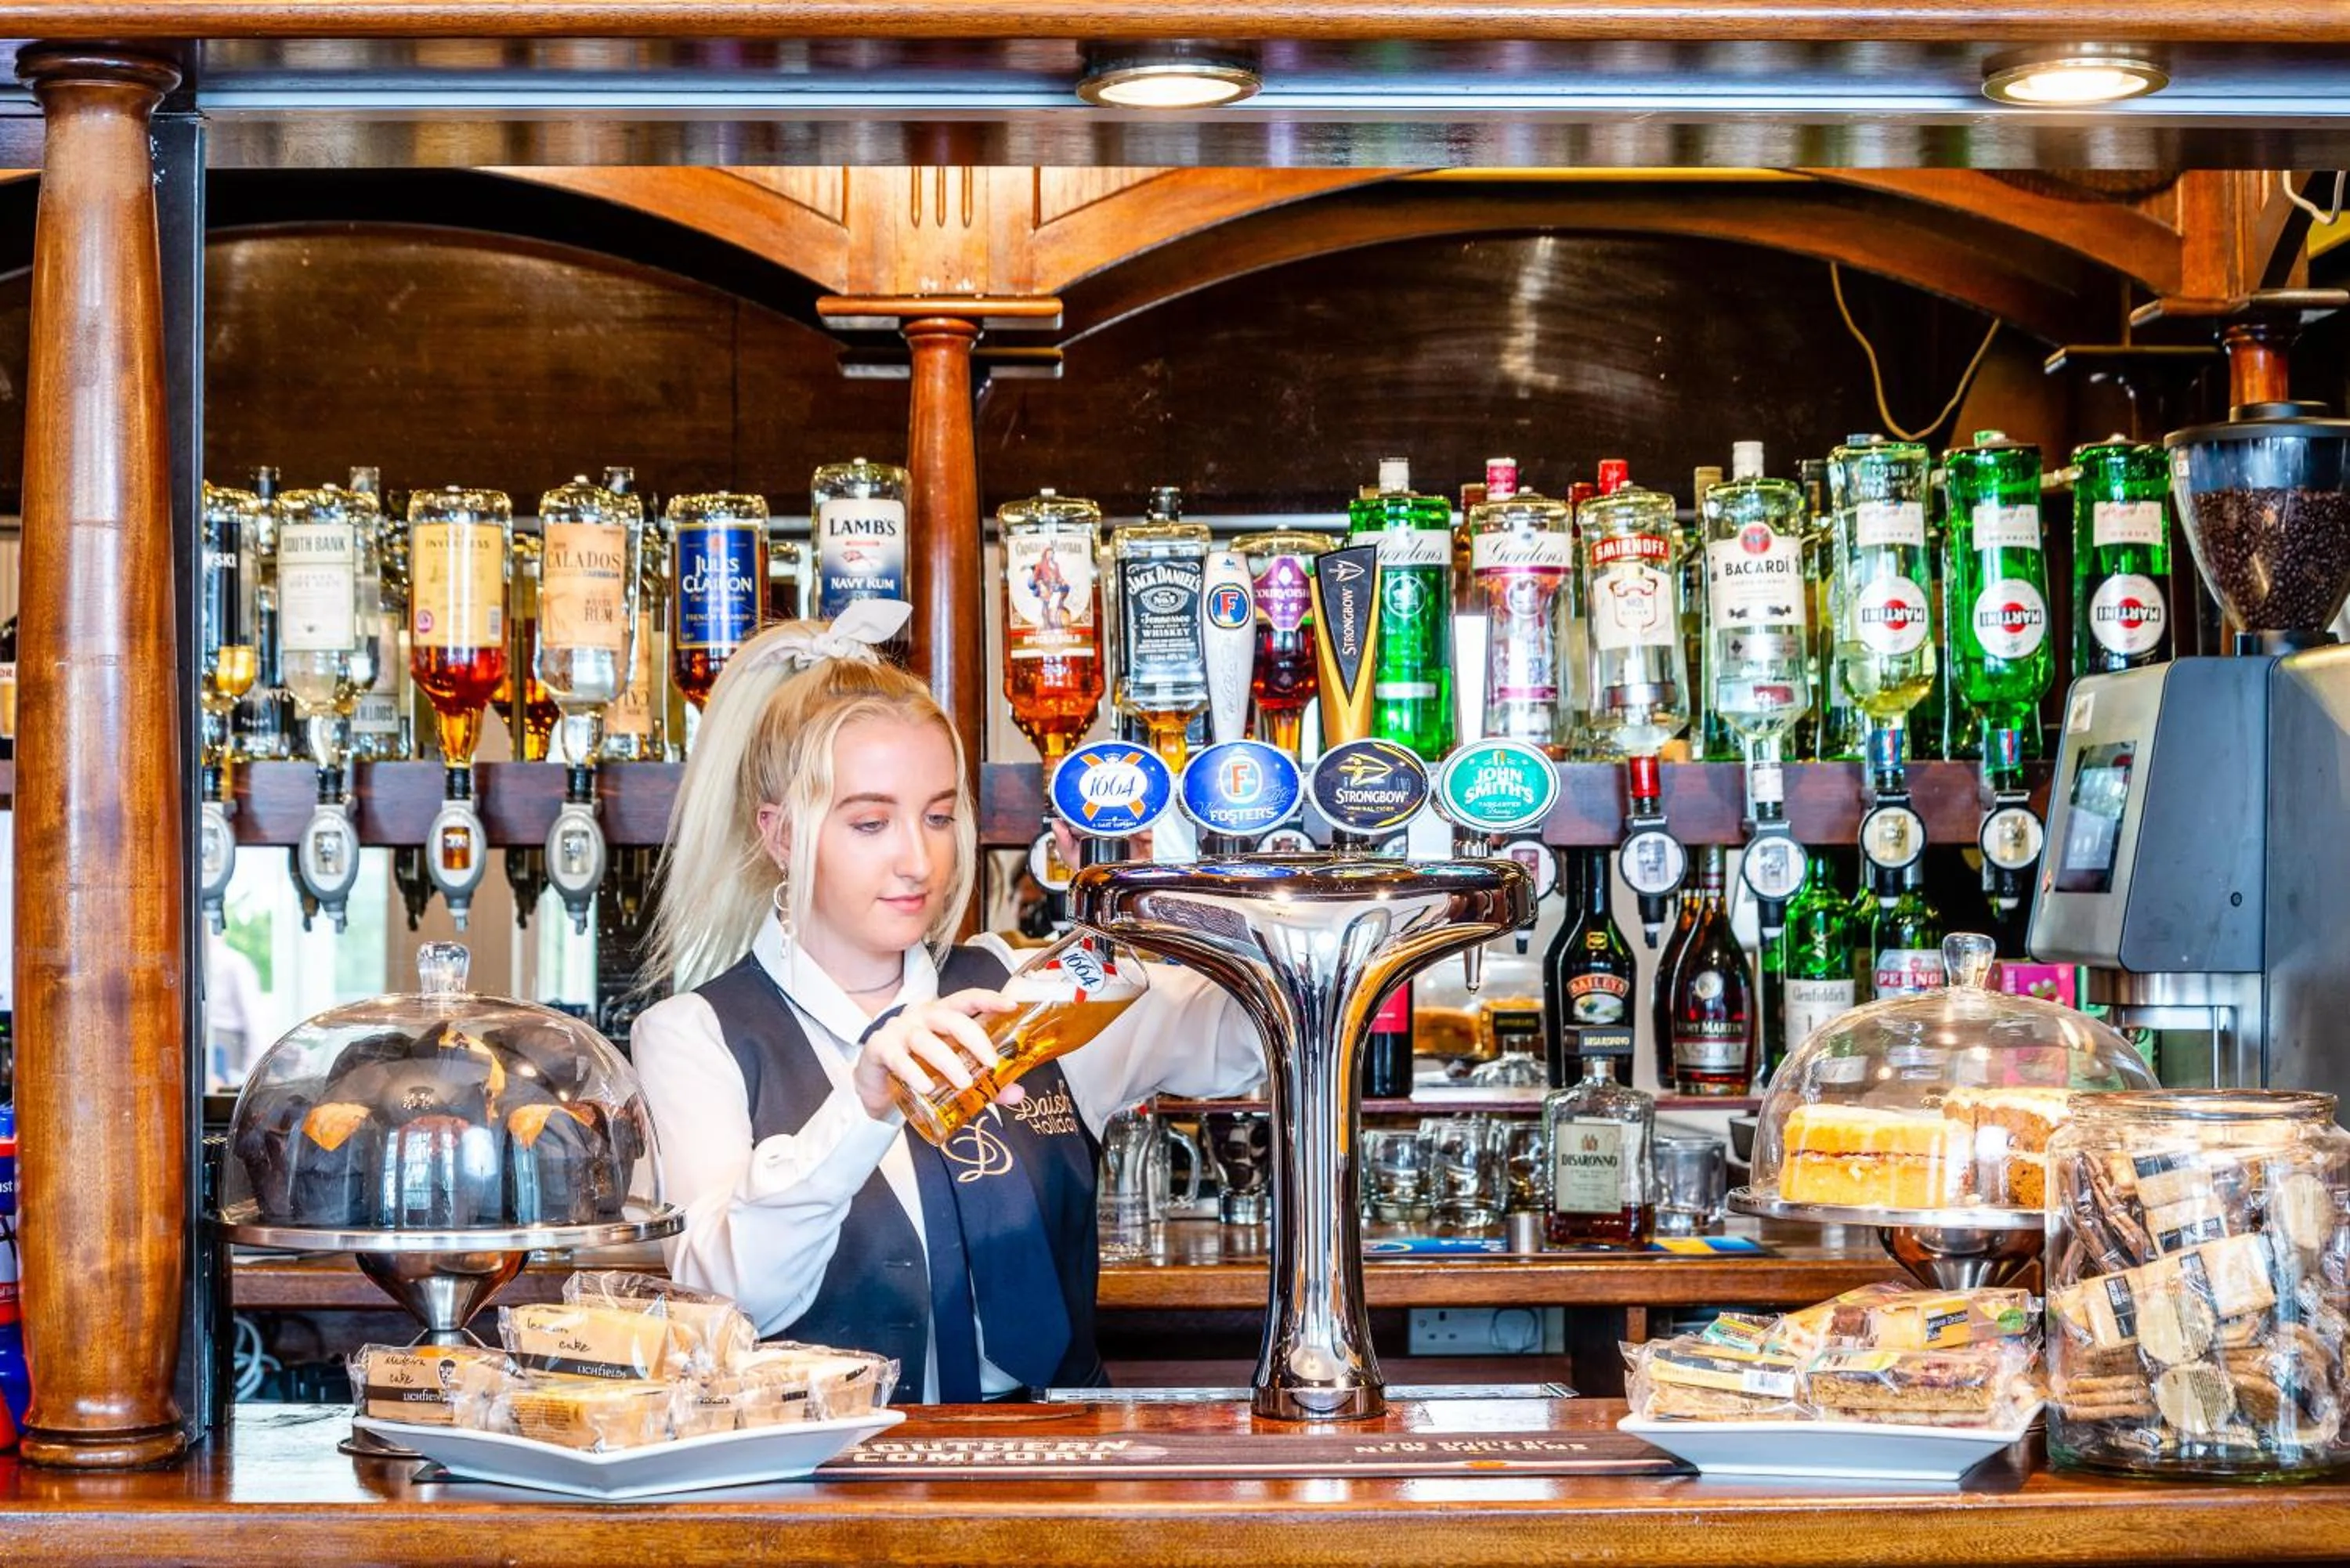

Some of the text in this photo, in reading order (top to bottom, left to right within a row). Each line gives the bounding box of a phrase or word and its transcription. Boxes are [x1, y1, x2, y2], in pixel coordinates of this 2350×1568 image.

[830, 518, 896, 537] LAMB'S
[1596, 538, 1665, 562] SMIRNOFF
[831, 576, 895, 590] NAVY RUM
[1127, 571, 1156, 594] JACK
[1220, 591, 1238, 618] F
[1343, 588, 1357, 656] STRONGBOW
[2096, 606, 2161, 622] MARTINI
[1141, 628, 1191, 638] WHISKEY
[1474, 767, 1523, 784] JOHN
[1088, 775, 1137, 797] 1664
[1335, 787, 1406, 804] STRONGBOW
[1062, 952, 1101, 988] 1664
[1878, 970, 1943, 986] PERNO
[1571, 977, 1625, 996] BAILEYS
[1561, 1153, 1618, 1168] DISARONNO
[559, 1337, 591, 1353] cake
[852, 1451, 1112, 1462] COMFORT
